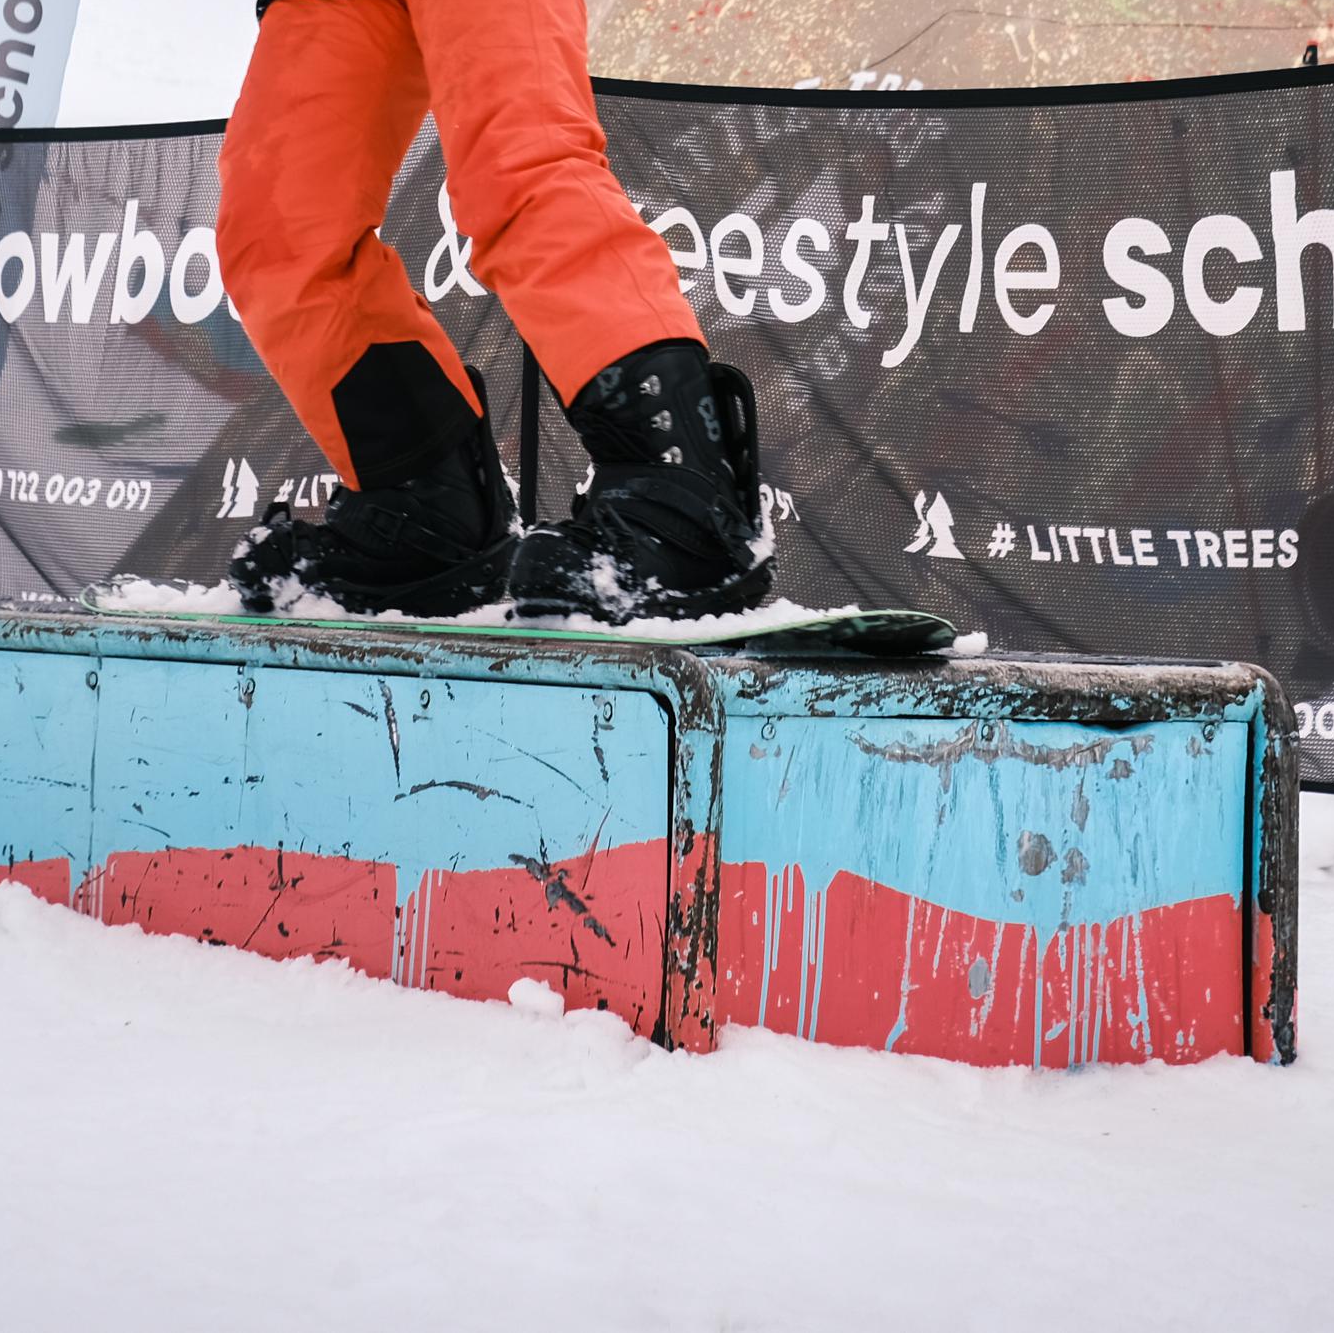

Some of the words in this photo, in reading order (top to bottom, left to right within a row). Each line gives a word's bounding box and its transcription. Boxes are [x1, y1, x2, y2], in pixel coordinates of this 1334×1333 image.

[631, 181, 1061, 368] eestyle
[7, 469, 40, 503] 722
[45, 474, 102, 507] 003
[106, 479, 152, 512] 097
[273, 474, 345, 508] #LIT
[1026, 524, 1159, 566] LITTLE
[1166, 528, 1300, 568] TREES
